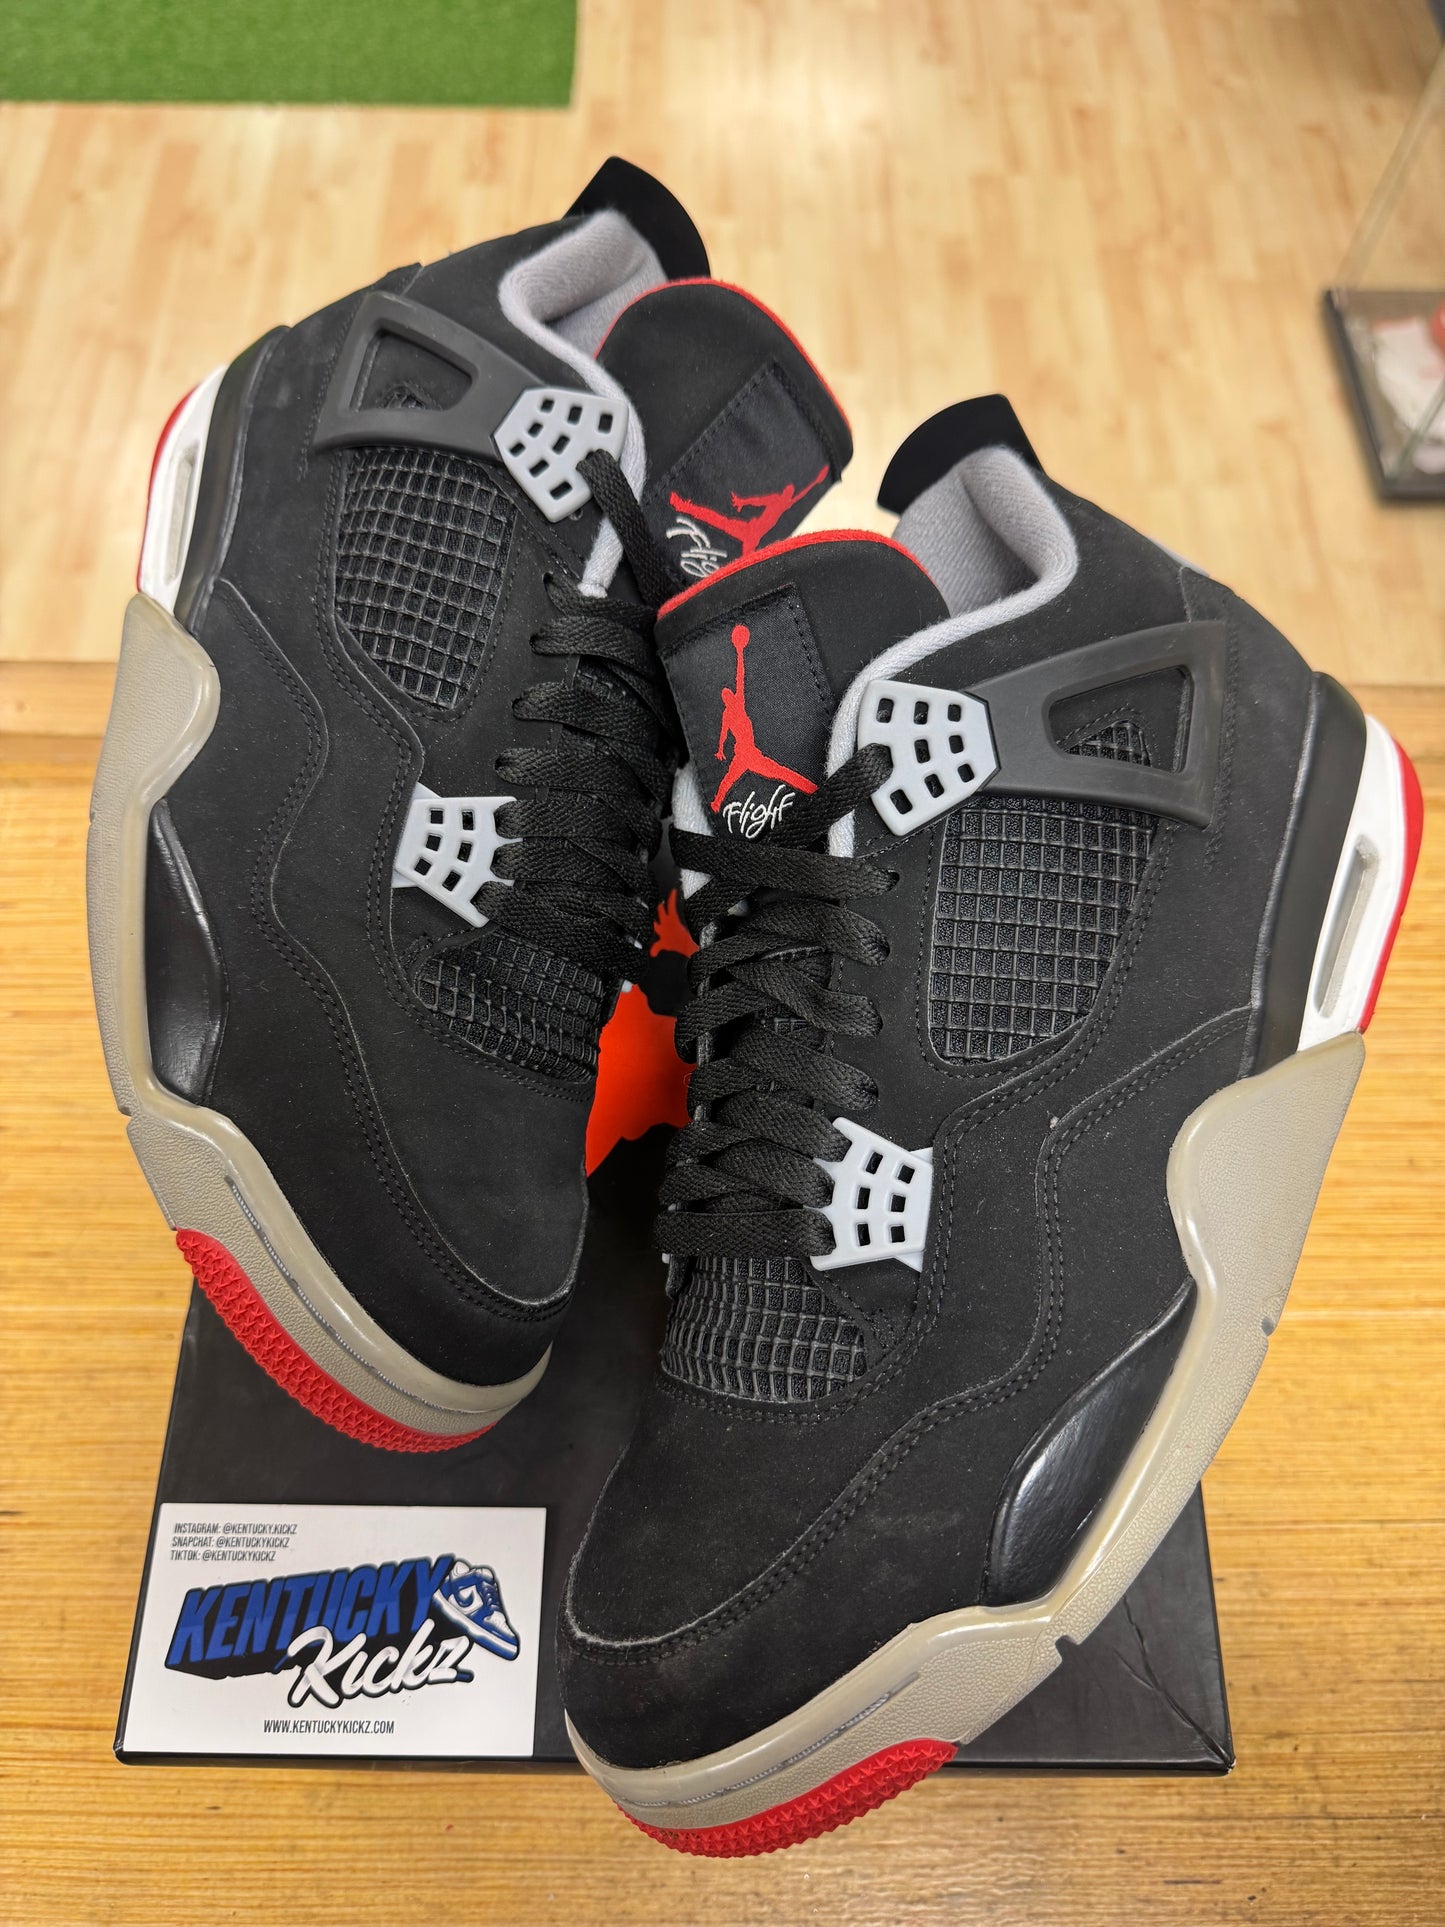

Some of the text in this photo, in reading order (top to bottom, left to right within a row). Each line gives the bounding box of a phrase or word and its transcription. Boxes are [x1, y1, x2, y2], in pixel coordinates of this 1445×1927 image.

[666, 516, 727, 578] Flig
[723, 784, 796, 839] Flight
[172, 1536, 290, 1548] SNAPCHAT: @KENTUCKYKICKZ
[174, 1522, 298, 1535] INSTAGRAM: @KENTUCKY.KICKZ
[170, 1549, 276, 1562] TIKTOK: @KENTUCKYKICKZ
[166, 1555, 455, 1668] KENTUCKY
[288, 1618, 471, 1706] Kickz
[263, 1719, 395, 1735] WWW.KENTUCKYKICKZ.COM
